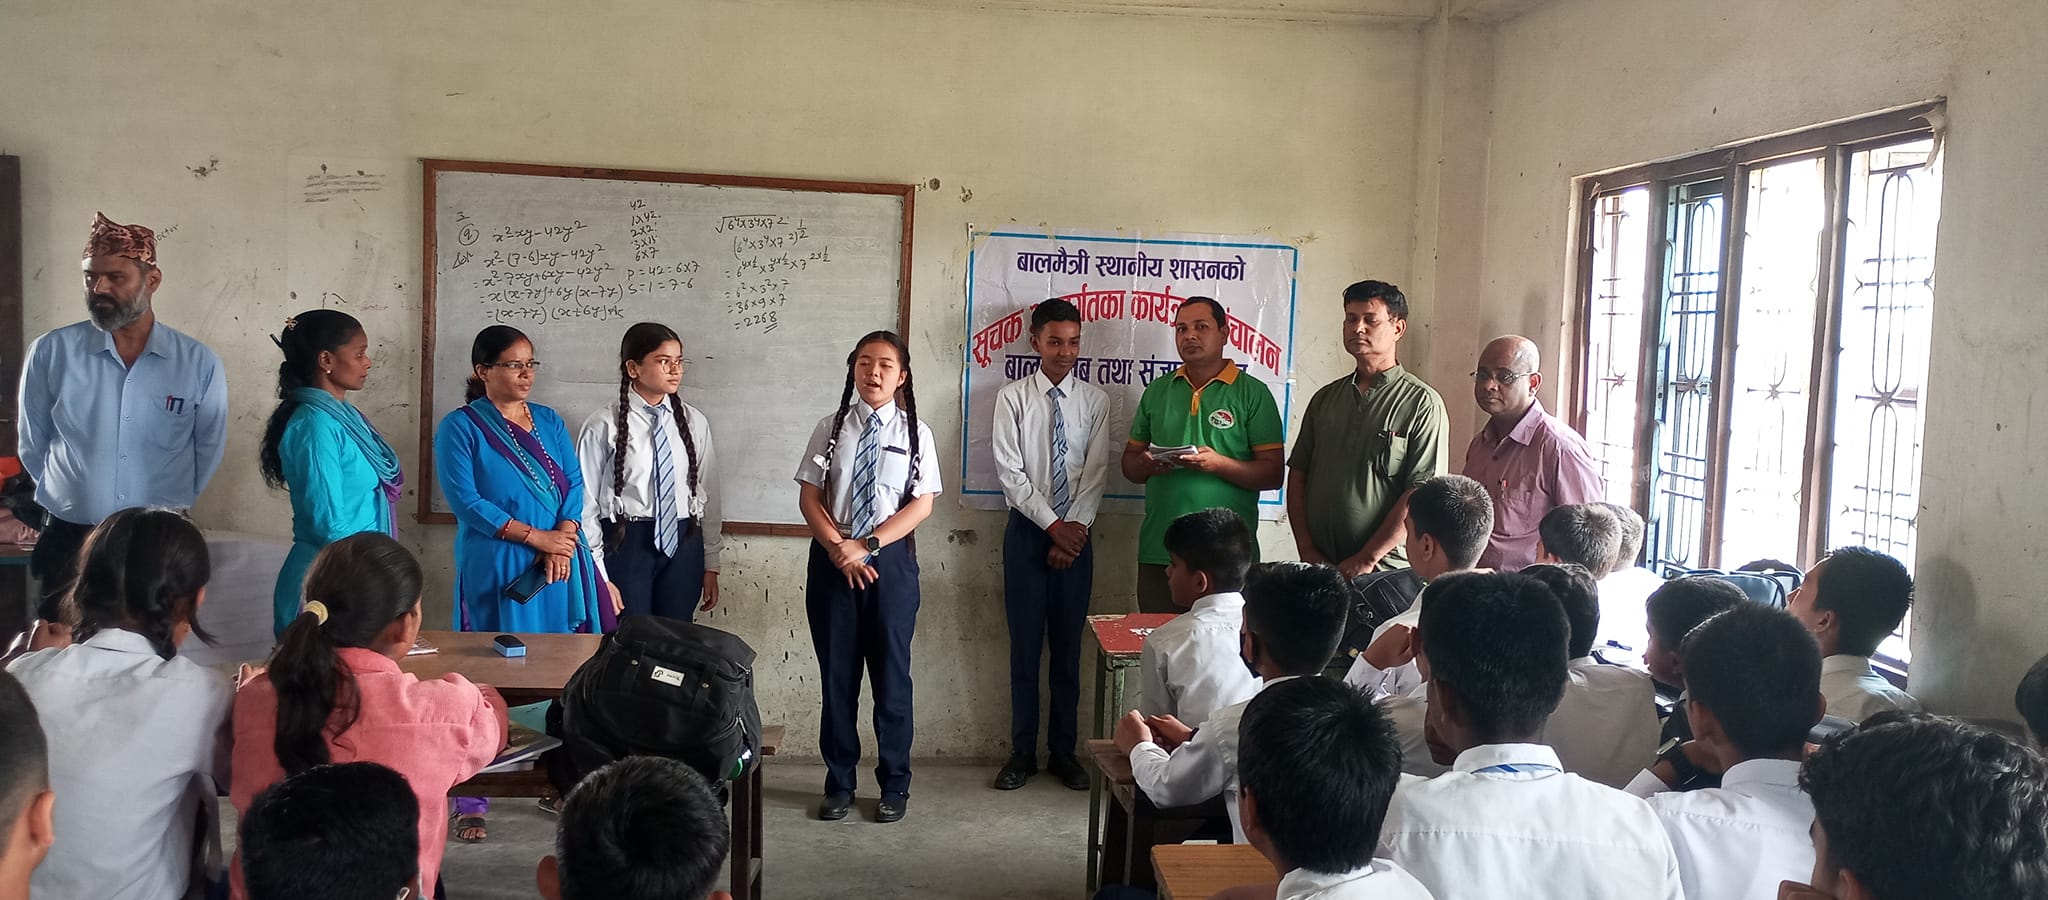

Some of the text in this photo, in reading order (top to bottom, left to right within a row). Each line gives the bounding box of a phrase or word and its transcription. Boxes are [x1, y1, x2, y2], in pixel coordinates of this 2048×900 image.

[630, 199, 646, 211] 42
[1017, 247, 1246, 281] बालमैत्री स्थानीय शासनको
[972, 308, 1025, 369] सूचक
[1098, 358, 1133, 385] तथा
